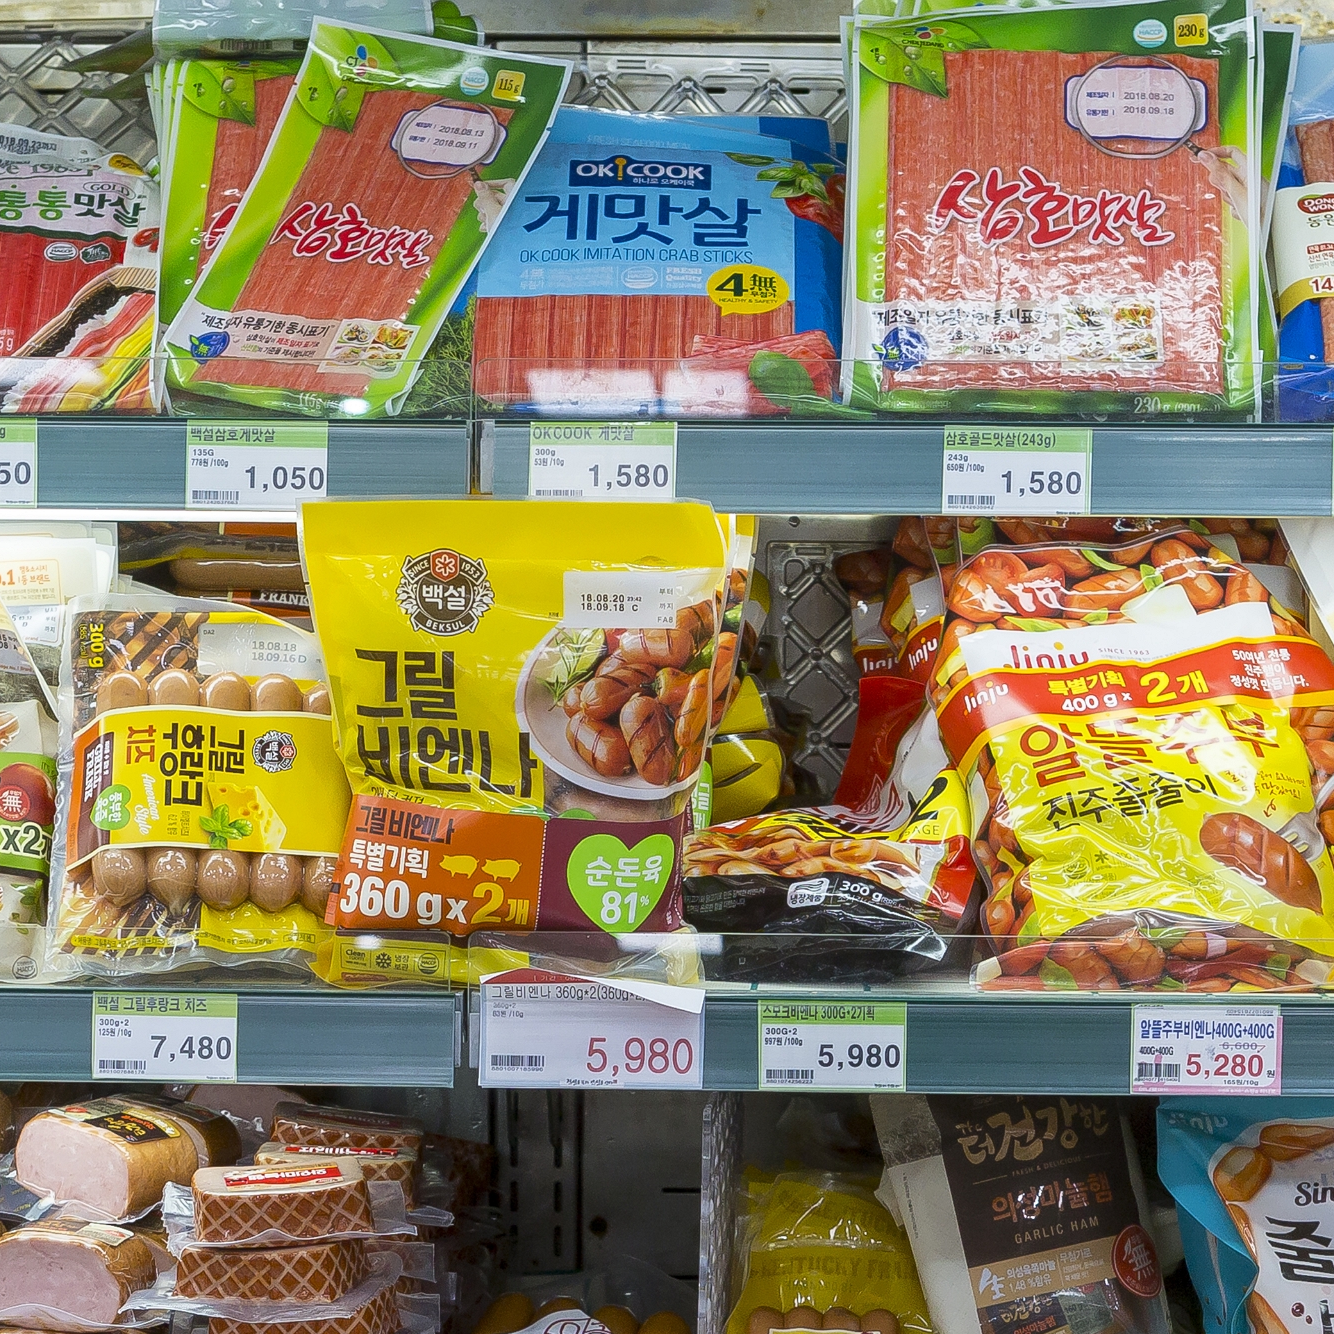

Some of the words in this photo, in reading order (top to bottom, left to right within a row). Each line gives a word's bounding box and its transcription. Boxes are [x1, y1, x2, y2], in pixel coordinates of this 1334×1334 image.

[522, 191, 762, 246] 게맛살
[931, 166, 1175, 249] 삼호맛살
[946, 432, 1055, 448] 삼호골드맛살(243g)
[948, 454, 968, 462] 243g
[246, 466, 324, 492] 1,050
[589, 464, 668, 490] 1,580
[1002, 471, 1081, 497] 1,580
[422, 584, 467, 611] 백설
[355, 648, 458, 722] 그릴
[357, 724, 539, 797] 비엔나
[348, 837, 428, 878] 특별기획
[584, 853, 661, 888] 순돈육
[492, 985, 550, 998] 그릴비엔나
[98, 997, 119, 1012] 백설
[124, 997, 180, 1012] 그릴후랑크
[185, 998, 206, 1013] 치즈
[151, 1036, 231, 1062] 7,480
[587, 1038, 692, 1076] 5,980
[818, 1044, 900, 1070] 5,980
[1186, 1053, 1263, 1079] 5,280
[1013, 1228, 1061, 1245] GARLIC
[1063, 1216, 1100, 1234] HAM
